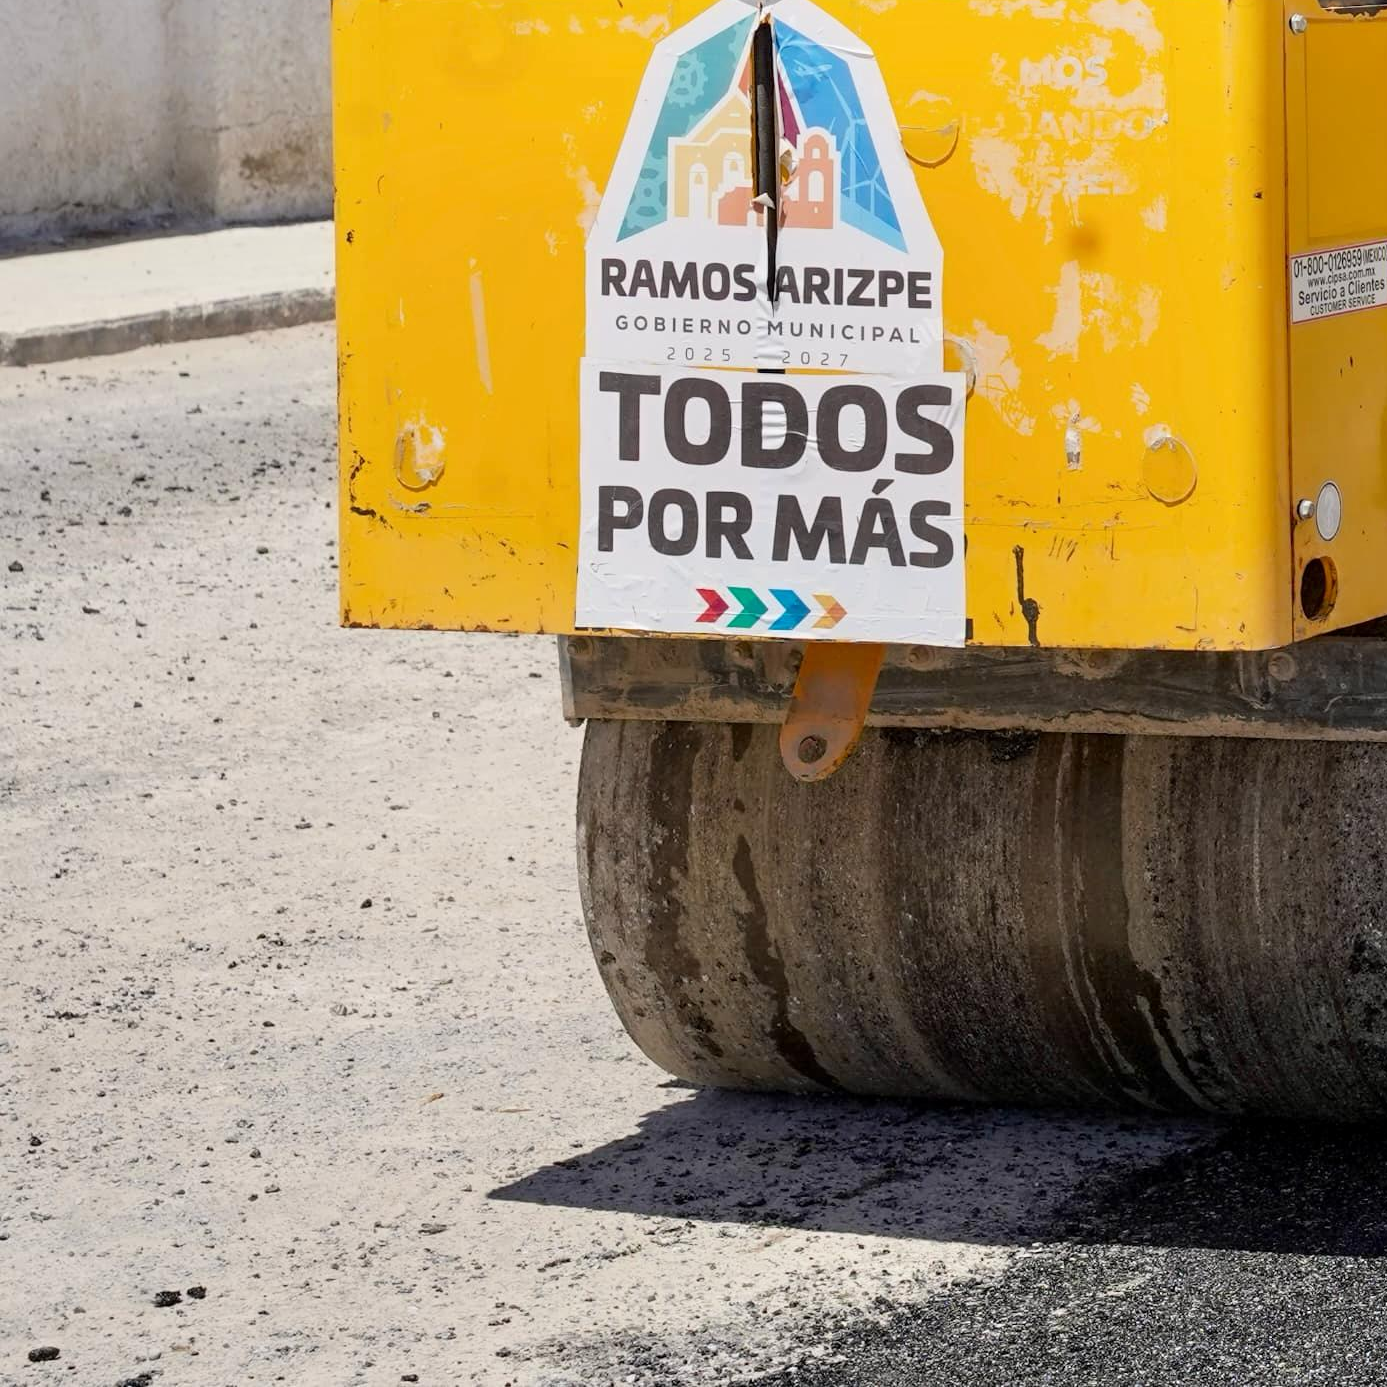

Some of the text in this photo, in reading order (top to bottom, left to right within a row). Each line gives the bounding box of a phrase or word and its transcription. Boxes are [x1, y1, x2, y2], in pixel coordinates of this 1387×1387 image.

[1294, 244, 1387, 278] 01-800-0126959 (MEXICO)
[601, 258, 932, 309] RAMOS ARIZPE
[1308, 267, 1376, 288] www.cipsa.com.mx
[1298, 278, 1385, 306] Servicio a Clientes
[1310, 294, 1376, 316] CUSTOMER SERVICE
[615, 315, 920, 343] GOBIERNO MUNICIPAL
[666, 347, 731, 362] 2025
[782, 350, 849, 367] 2027
[599, 371, 954, 475] TODOS
[598, 478, 954, 569] POR MÁS
